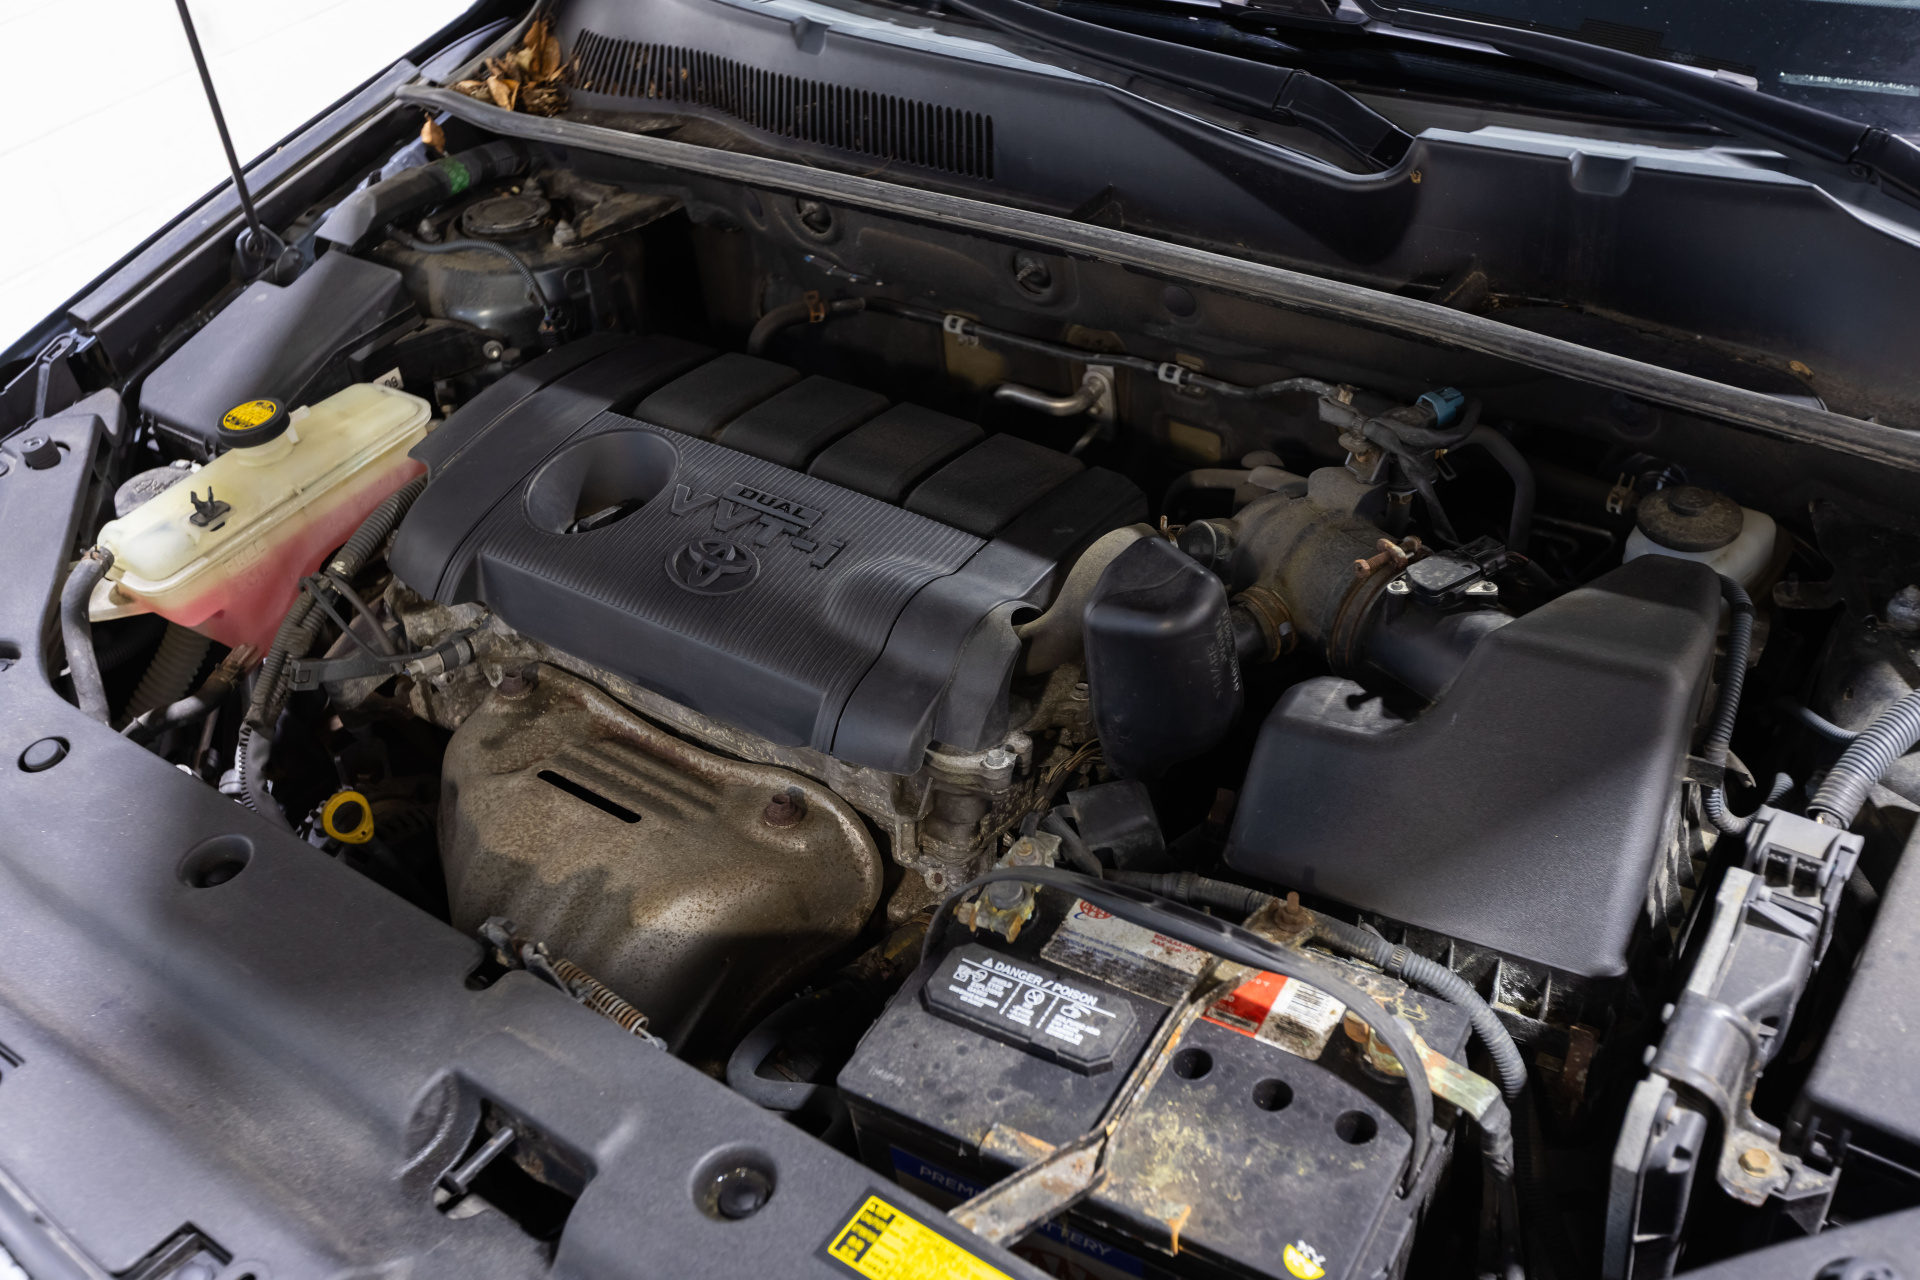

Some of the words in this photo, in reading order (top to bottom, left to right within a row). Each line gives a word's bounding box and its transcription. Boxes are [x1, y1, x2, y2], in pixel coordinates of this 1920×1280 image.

[738, 488, 809, 520] DUAL
[994, 961, 1044, 987] DANGER
[1052, 982, 1099, 1007] POISON
[919, 1165, 980, 1198] PREMI
[1042, 1221, 1113, 1257] TTERY
